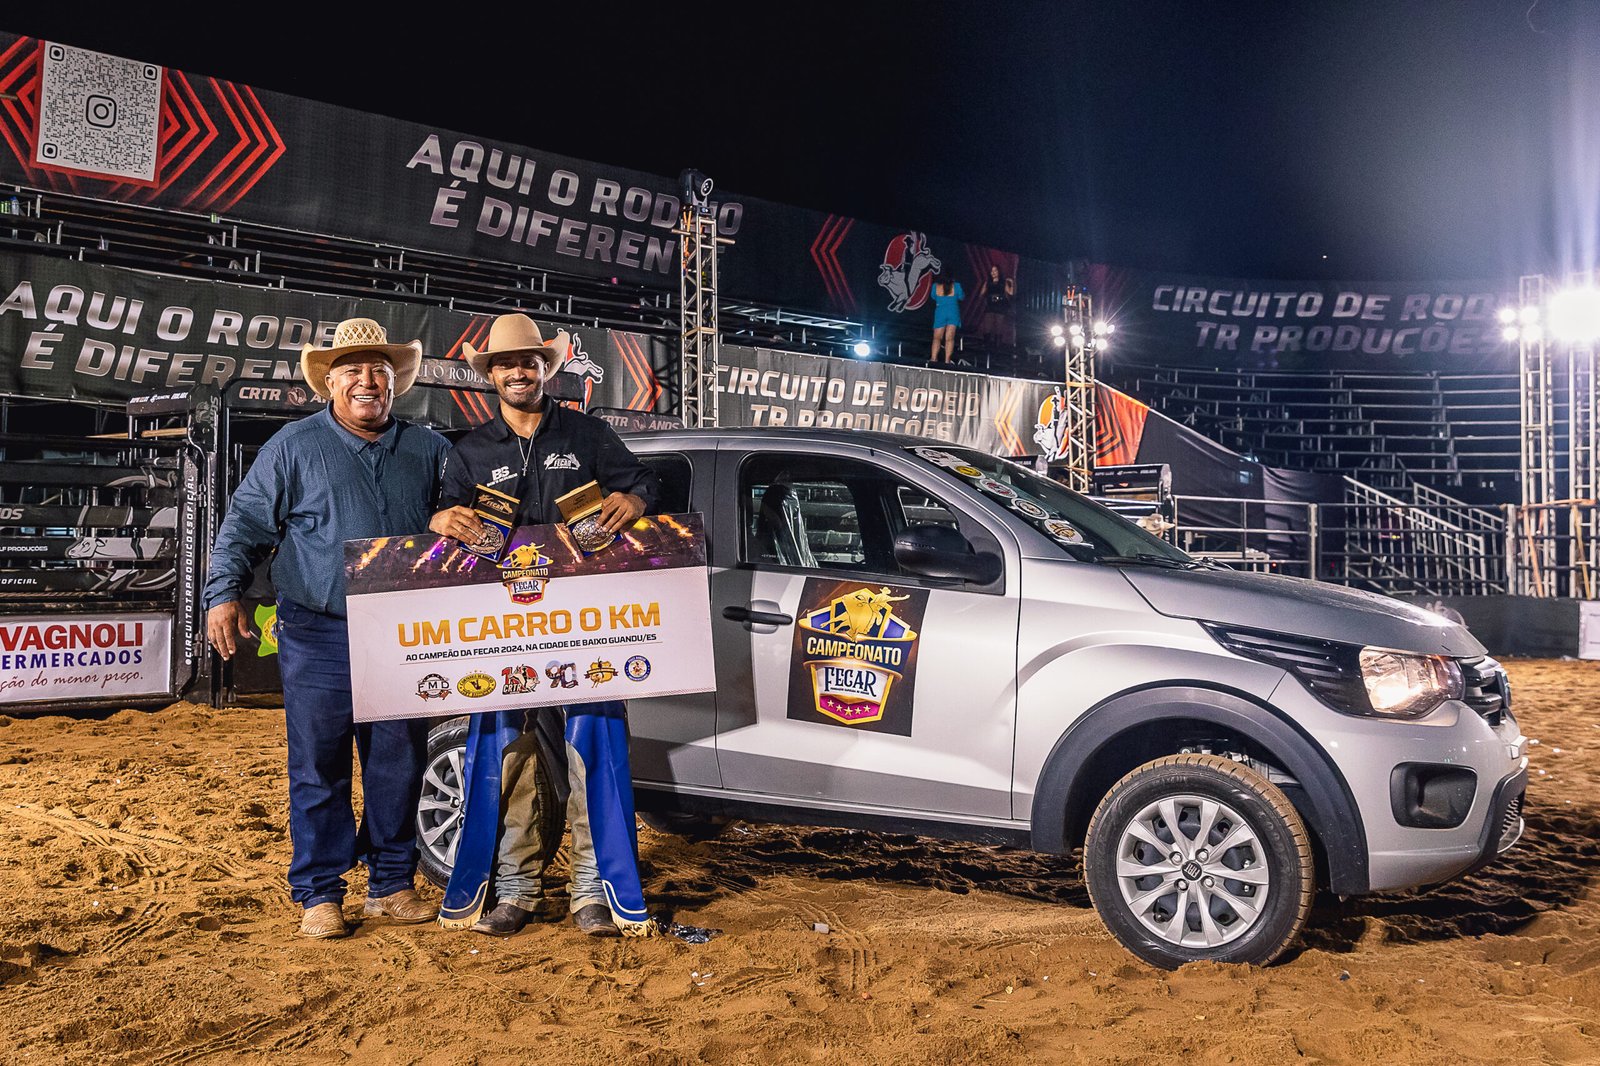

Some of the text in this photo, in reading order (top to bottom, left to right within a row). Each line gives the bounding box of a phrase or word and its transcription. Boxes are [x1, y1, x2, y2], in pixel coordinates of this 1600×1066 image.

[406, 134, 536, 195] AQUI
[548, 169, 579, 206] O
[430, 180, 466, 228] É
[0, 281, 144, 334] AQUI
[157, 306, 193, 341] O
[1152, 285, 1497, 322] CIRCUITO DE ROD
[20, 323, 64, 370] É
[1195, 322, 1501, 357] TR PRODUÇÕES
[433, 365, 445, 378] O
[239, 387, 281, 400] CRTR
[852, 381, 887, 406] DE
[892, 385, 980, 416] RODEIO
[751, 404, 788, 427] TR
[491, 466, 510, 481] BS
[502, 568, 549, 579] CAMPEONATO
[513, 580, 540, 593] FECAR
[0, 623, 143, 651] VAGNOLI
[398, 619, 451, 647] UM
[458, 609, 572, 643] CARRO
[609, 602, 661, 629] KM
[2, 649, 142, 670] ERMERCADOS
[406, 654, 418, 662] AO
[418, 649, 459, 661] CAMPEÃO
[460, 649, 472, 657] DA
[473, 647, 500, 656] FECAR
[500, 645, 525, 654] 2024,
[525, 643, 538, 651] NA
[538, 641, 569, 650] CIDADE
[582, 638, 607, 646] BAIXO
[608, 634, 657, 645] GUANDU/ES
[806, 636, 902, 666] CAMPEONATO
[31, 671, 48, 687] do
[54, 675, 99, 685] menor
[101, 671, 143, 689] preço.
[823, 666, 877, 697] FECAR
